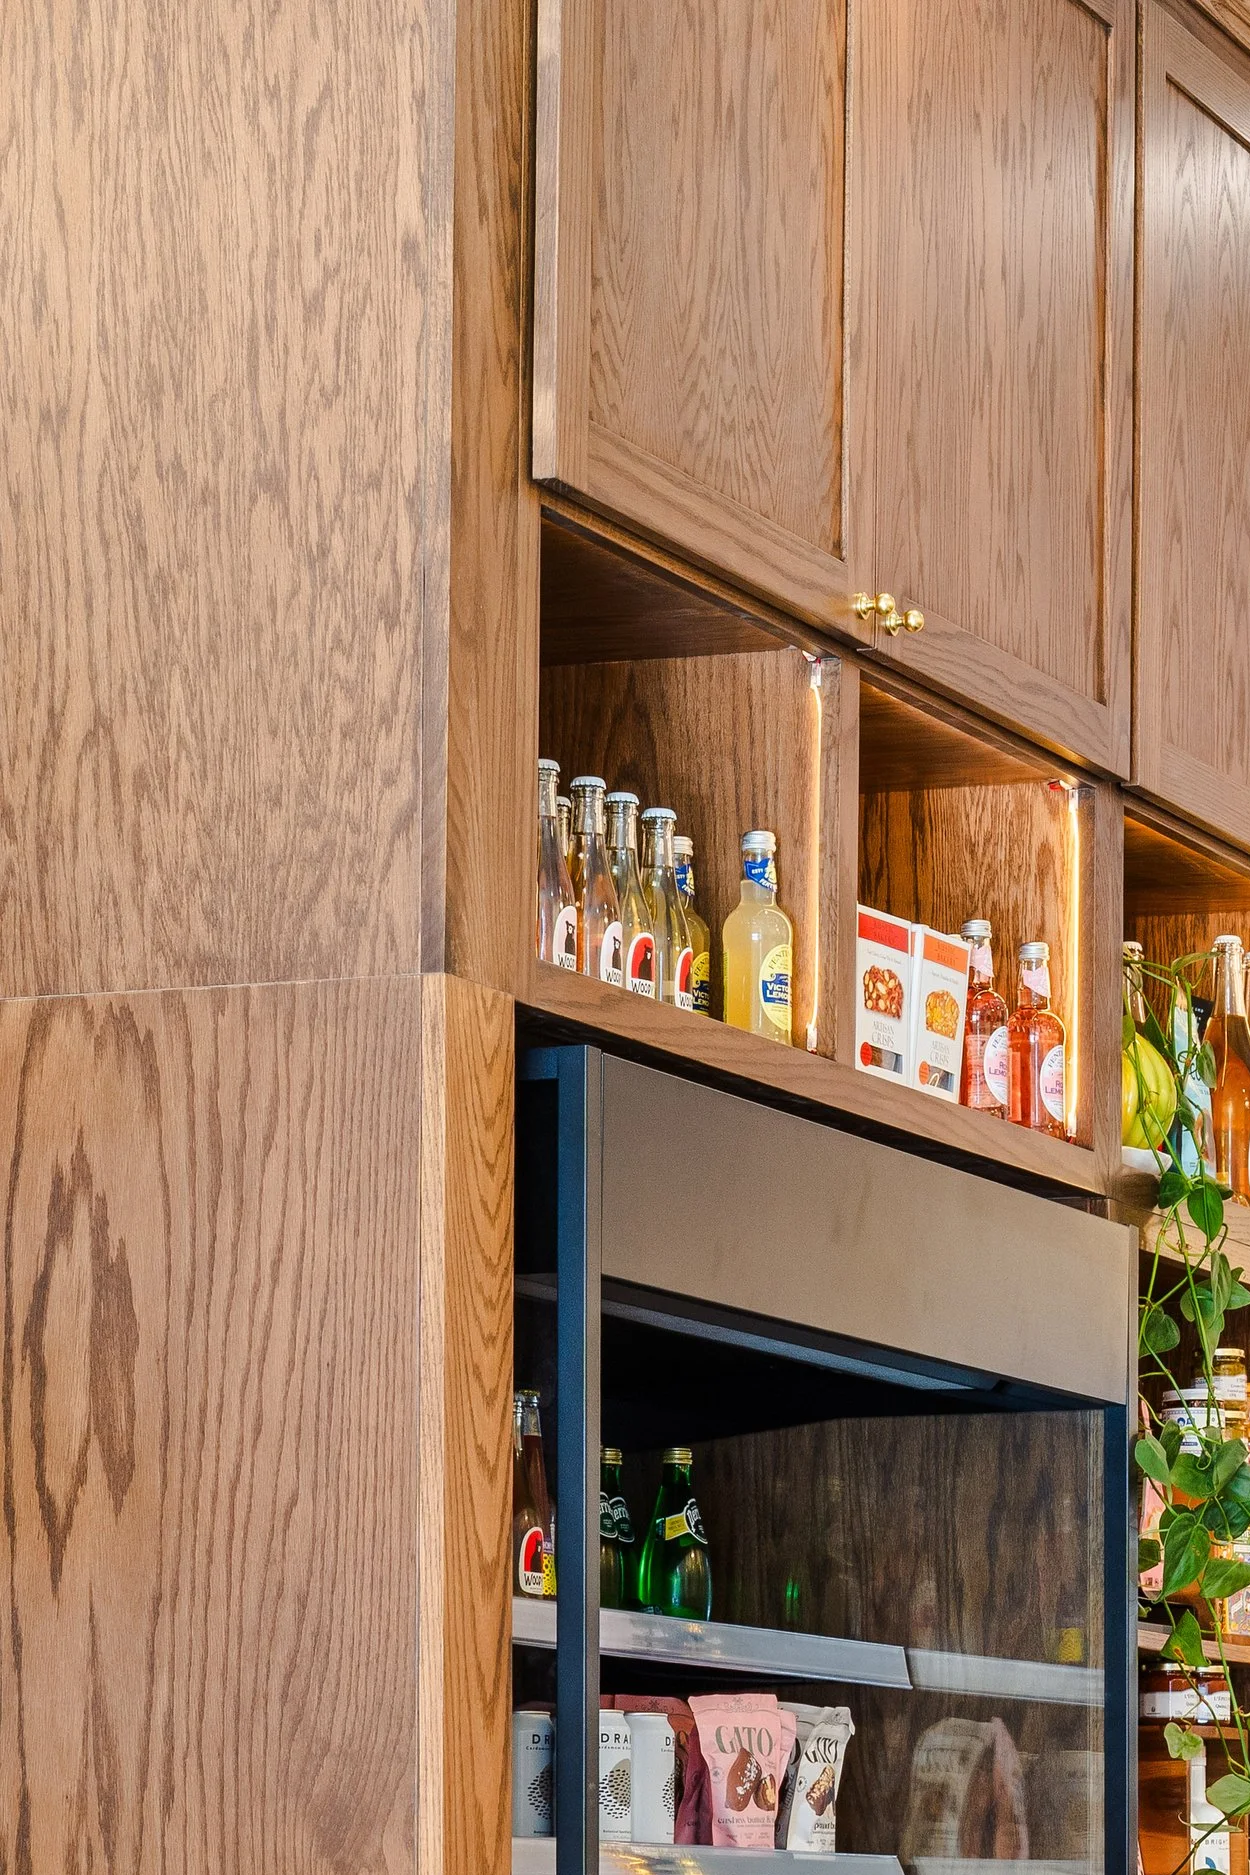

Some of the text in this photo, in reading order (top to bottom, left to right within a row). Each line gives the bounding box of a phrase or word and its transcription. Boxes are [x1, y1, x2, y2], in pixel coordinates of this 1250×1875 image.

[871, 1031, 895, 1049] CRISPS
[600, 1733, 632, 1744] DRA
[715, 1725, 774, 1757] GATO
